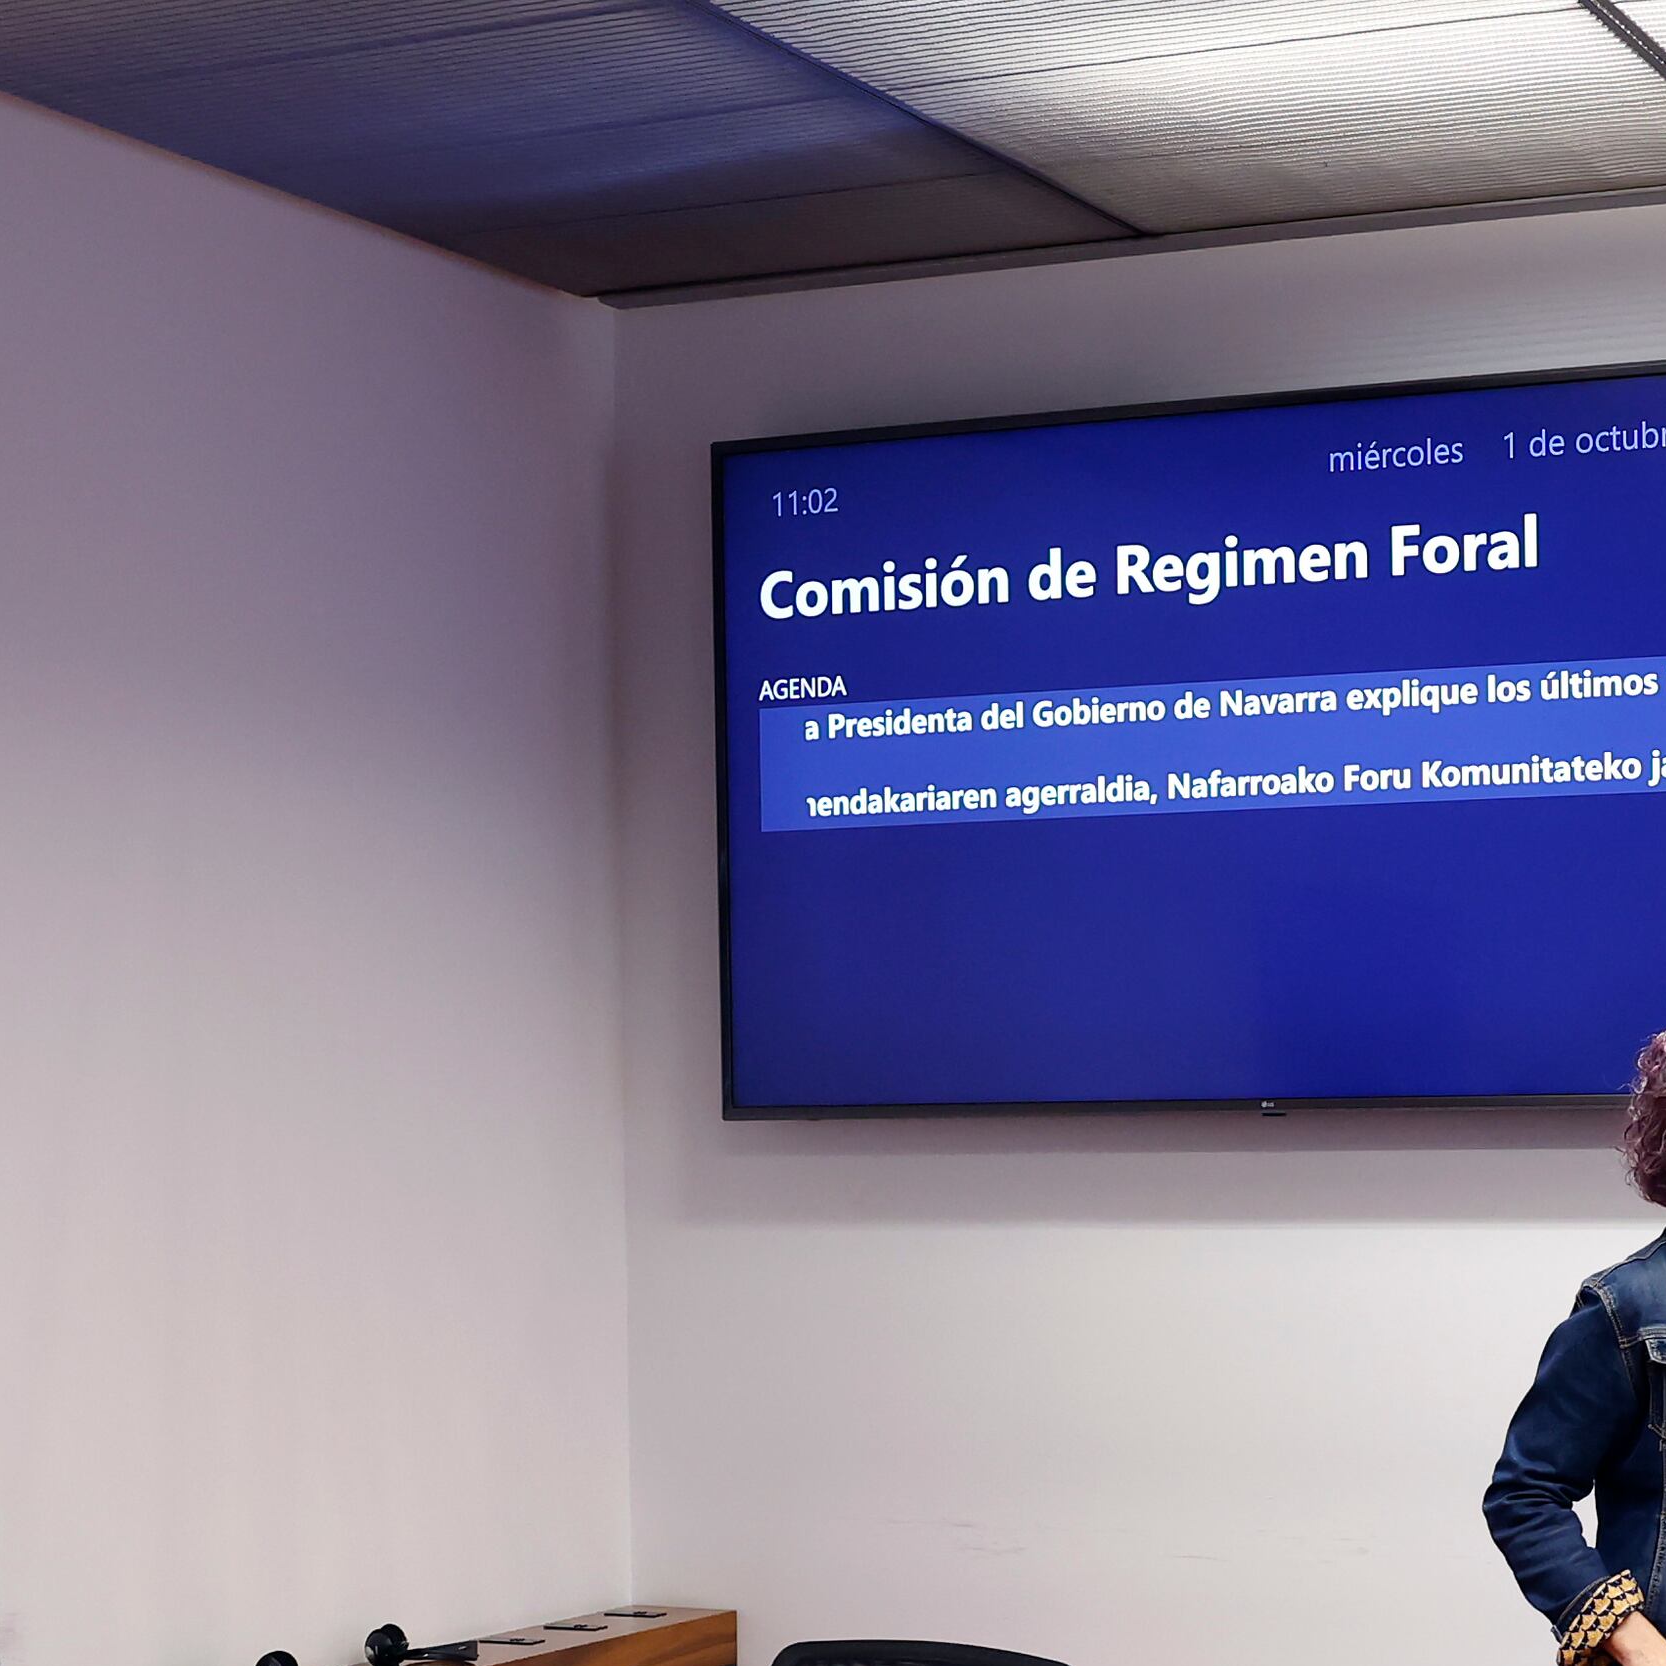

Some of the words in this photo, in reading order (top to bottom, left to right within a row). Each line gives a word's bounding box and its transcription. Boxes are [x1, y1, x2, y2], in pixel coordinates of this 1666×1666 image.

[1330, 437, 1463, 472] miércoles
[1504, 432, 1514, 459] 1
[1529, 428, 1565, 457] de
[773, 488, 838, 517] 11:02
[760, 554, 1009, 619] Comisión
[1028, 547, 1097, 601] de
[1116, 535, 1368, 605] Regimen
[1391, 513, 1538, 576] Foral
[758, 675, 847, 701] AGENDA
[805, 720, 819, 741] a
[828, 707, 973, 739] Presidenta
[980, 700, 1024, 731] del
[1032, 696, 1166, 728] Gobierno
[1173, 691, 1211, 720] de
[1220, 689, 1337, 717] Navarra
[1346, 678, 1479, 716] explique
[1487, 674, 1532, 703] los
[1540, 669, 1659, 701] últimos
[1005, 774, 1158, 815] agerraldia,
[1167, 765, 1335, 800] Nafarroako
[1344, 764, 1411, 792] Foru
[1421, 751, 1642, 789] Komunitateko
